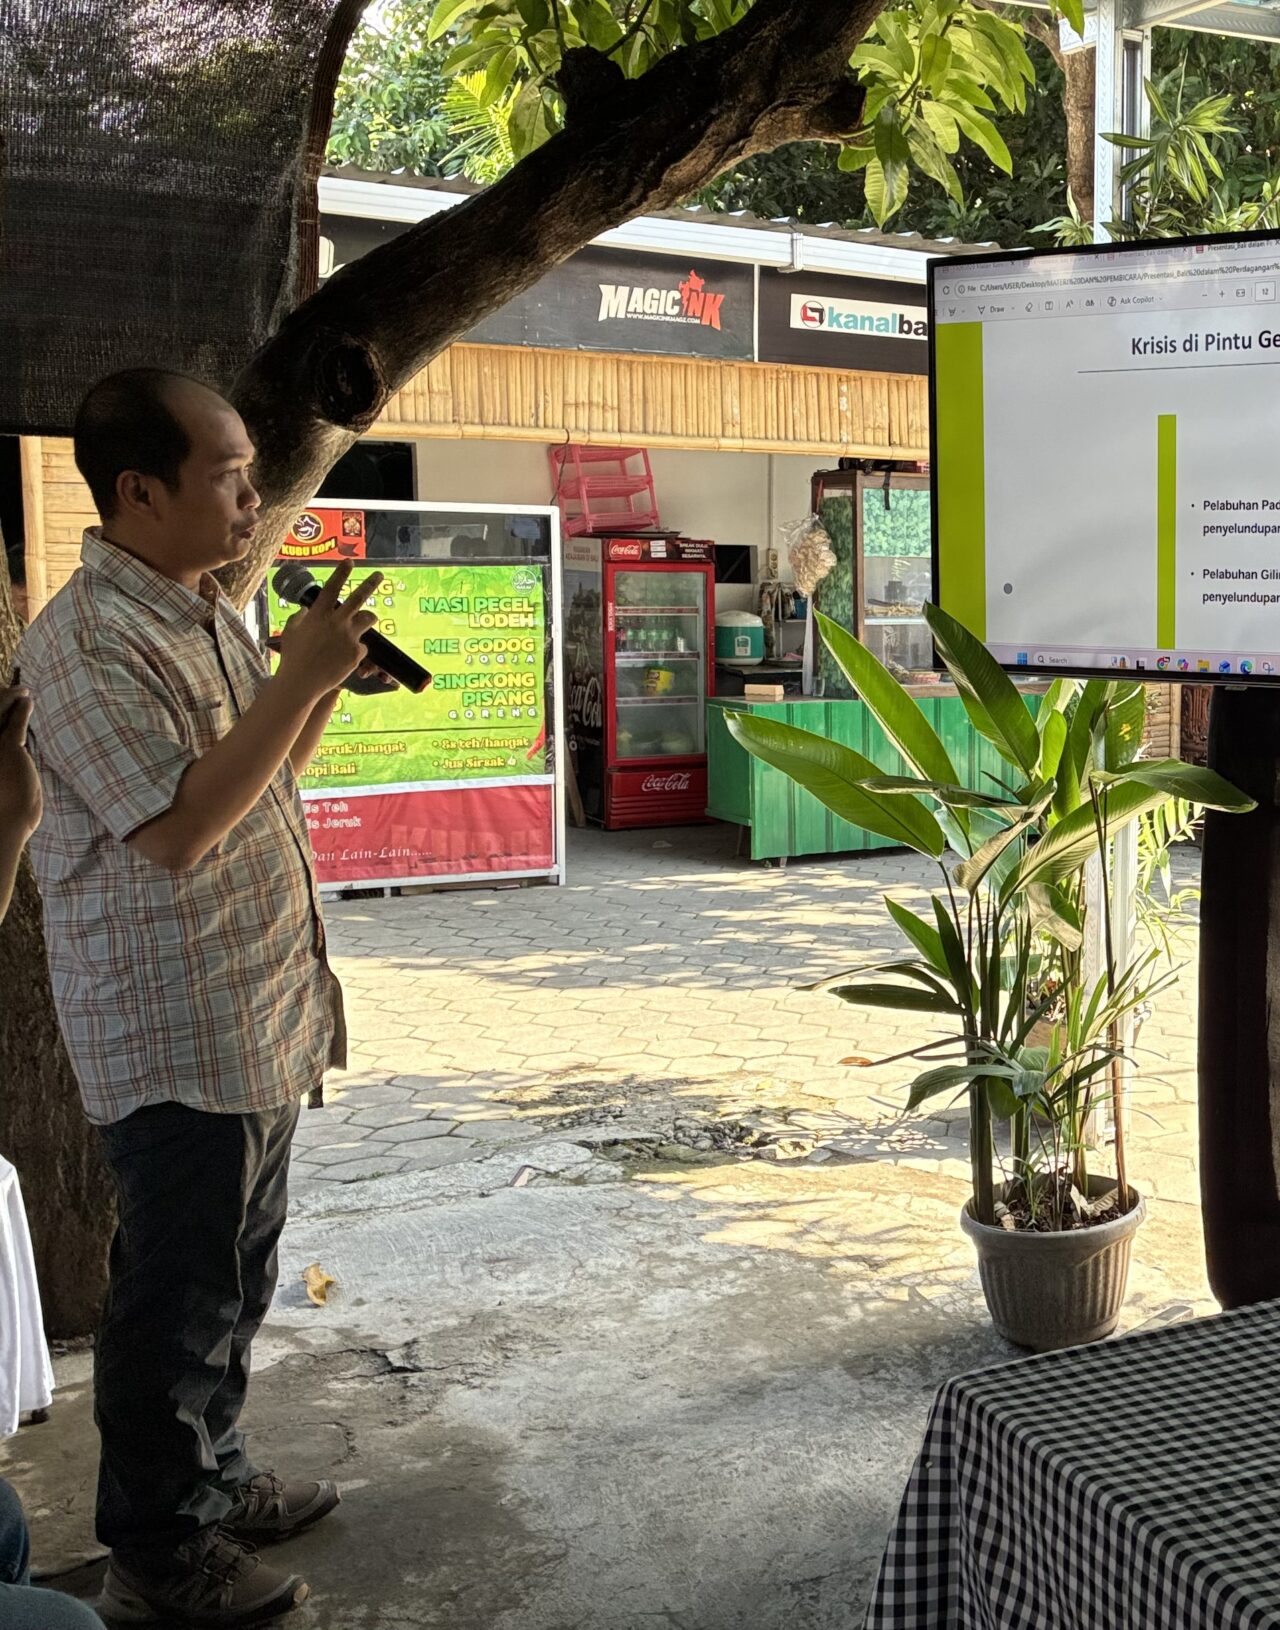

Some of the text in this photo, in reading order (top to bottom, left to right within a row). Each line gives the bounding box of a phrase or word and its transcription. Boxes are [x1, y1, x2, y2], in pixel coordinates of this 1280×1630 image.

[598, 284, 681, 322] MAGIC
[1132, 296, 1154, 304] Copilot
[827, 306, 928, 336] kanalba
[1131, 336, 1177, 355] Krisis
[1183, 333, 1199, 352] di
[1205, 332, 1252, 351] Pintu
[1203, 500, 1258, 511] Pelabuhan
[282, 538, 336, 556] KUBU KOPI
[611, 544, 639, 556] Coca-Cola
[1202, 569, 1258, 580] Pelabuhan
[420, 597, 534, 612] NASI PECEL
[469, 613, 534, 628] LODEH
[424, 638, 535, 654] MIE GODOG
[465, 654, 535, 664] JOGJA
[1049, 656, 1068, 665] Search
[433, 672, 535, 689] SINGKONG
[462, 690, 535, 707] PISANG
[448, 708, 536, 719] GORENG
[302, 763, 356, 777] opi Bali
[443, 757, 504, 769] Jus Sirsak
[641, 772, 691, 792] Coca-Cola
[303, 802, 348, 814] Es Teh
[322, 816, 361, 828] Jeruk
